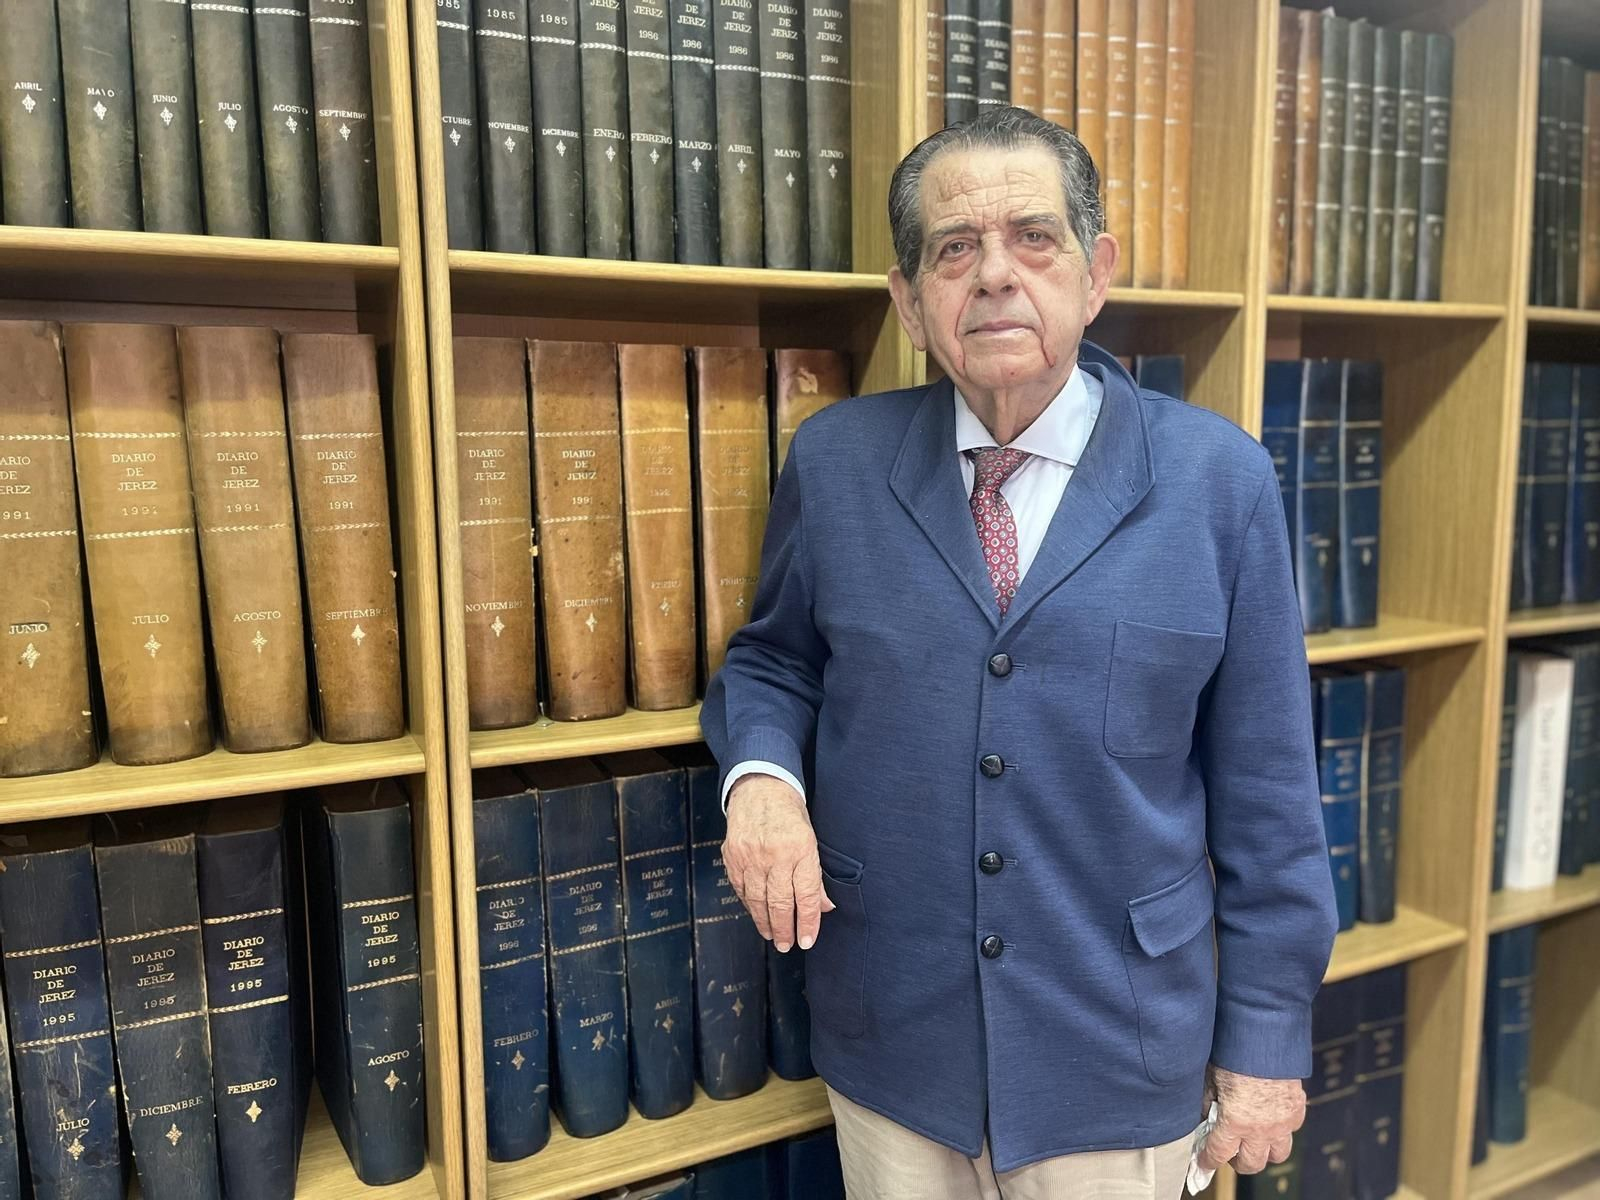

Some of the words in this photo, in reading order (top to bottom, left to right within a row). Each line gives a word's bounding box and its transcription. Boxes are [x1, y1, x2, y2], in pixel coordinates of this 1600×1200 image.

[437, 0, 460, 9] 985
[685, 4, 698, 14] DE
[767, 3, 798, 15] DIARIO
[487, 8, 516, 21] 1985
[633, 5, 663, 18] JEREZ
[732, 11, 745, 21] DE
[812, 8, 843, 19] DIARIO
[540, 13, 568, 26] 1985
[677, 15, 706, 28] JEREZ
[778, 17, 791, 27] DE
[595, 21, 616, 33] 1986
[724, 22, 752, 33] JEREZ
[823, 21, 836, 31] DE
[639, 29, 659, 41] 1986
[771, 28, 798, 40] JEREZ
[816, 32, 843, 43] JEREZ
[682, 39, 702, 50] 1986
[728, 45, 748, 56] 1986
[775, 51, 794, 62] 1986
[820, 54, 839, 64] 1986
[14, 81, 43, 91] ABRIL
[152, 94, 178, 104] JUNIO
[218, 101, 242, 112] JULIO
[273, 103, 308, 115] AGOSTO
[442, 115, 472, 126] CTUBRE
[488, 121, 530, 134] NOVIEMBRE
[542, 128, 579, 139] DICIEMBRE
[593, 128, 625, 140] ENERO
[631, 132, 672, 145] FEBRERO
[679, 140, 712, 151] MARZO
[728, 144, 755, 155] ABRIL
[774, 148, 800, 159] MAYO
[818, 149, 844, 160] JUNIO
[111, 452, 156, 464] DIARIO
[216, 452, 259, 462] DIARIO
[317, 450, 357, 461] DIARIO
[469, 449, 505, 458] DIARIO
[562, 449, 595, 459] DIARIO
[0, 455, 31, 466] ARIO
[482, 460, 497, 468] DE
[575, 459, 588, 468] DE
[126, 467, 144, 477] DE
[230, 466, 247, 475] DE
[331, 462, 347, 471] DE
[0, 470, 17, 480] DE
[322, 474, 358, 484] JEREZ
[473, 471, 506, 481] JEREZ
[567, 471, 597, 481] JEREZ
[117, 480, 158, 492] JEREZ
[222, 478, 260, 489] JEREZ
[0, 485, 31, 495] EREZ
[329, 501, 354, 510] 1991
[479, 497, 502, 506] 1991
[226, 503, 260, 513] 1991
[3, 510, 31, 520] 991
[131, 614, 170, 625] JULIO
[233, 610, 281, 623] AGOSTO
[8, 623, 48, 635] JUNIO
[569, 881, 603, 896] DIARIO
[653, 879, 665, 889] DE
[645, 888, 673, 901] JEREZ
[502, 909, 516, 919] DE
[574, 902, 602, 916] JEREZ
[361, 911, 400, 925] DIARIO
[372, 924, 388, 935] DE
[493, 918, 525, 932] JEREZ
[223, 936, 265, 951] DIARIO
[364, 933, 399, 947] JEREZ
[499, 940, 519, 952] 1996
[132, 948, 176, 965] DIARIO
[237, 948, 253, 959] DE
[228, 957, 264, 971] JEREZ
[367, 954, 397, 968] 1995
[33, 965, 77, 980] DIARIO
[147, 962, 164, 973] DE
[47, 979, 64, 990] DE
[137, 972, 175, 988] JEREZ
[230, 978, 262, 993] 1995
[39, 989, 76, 1004] JEREZ
[144, 995, 176, 1010] 1995
[43, 1012, 76, 1027] 1995
[579, 1011, 614, 1028] MARZO
[494, 1028, 539, 1047] FEBRERO
[367, 1049, 410, 1067] AGOSTO
[227, 1077, 278, 1095] FEBRERO
[140, 1096, 203, 1118] DICIEMBRE
[56, 1117, 90, 1132] JULIO
